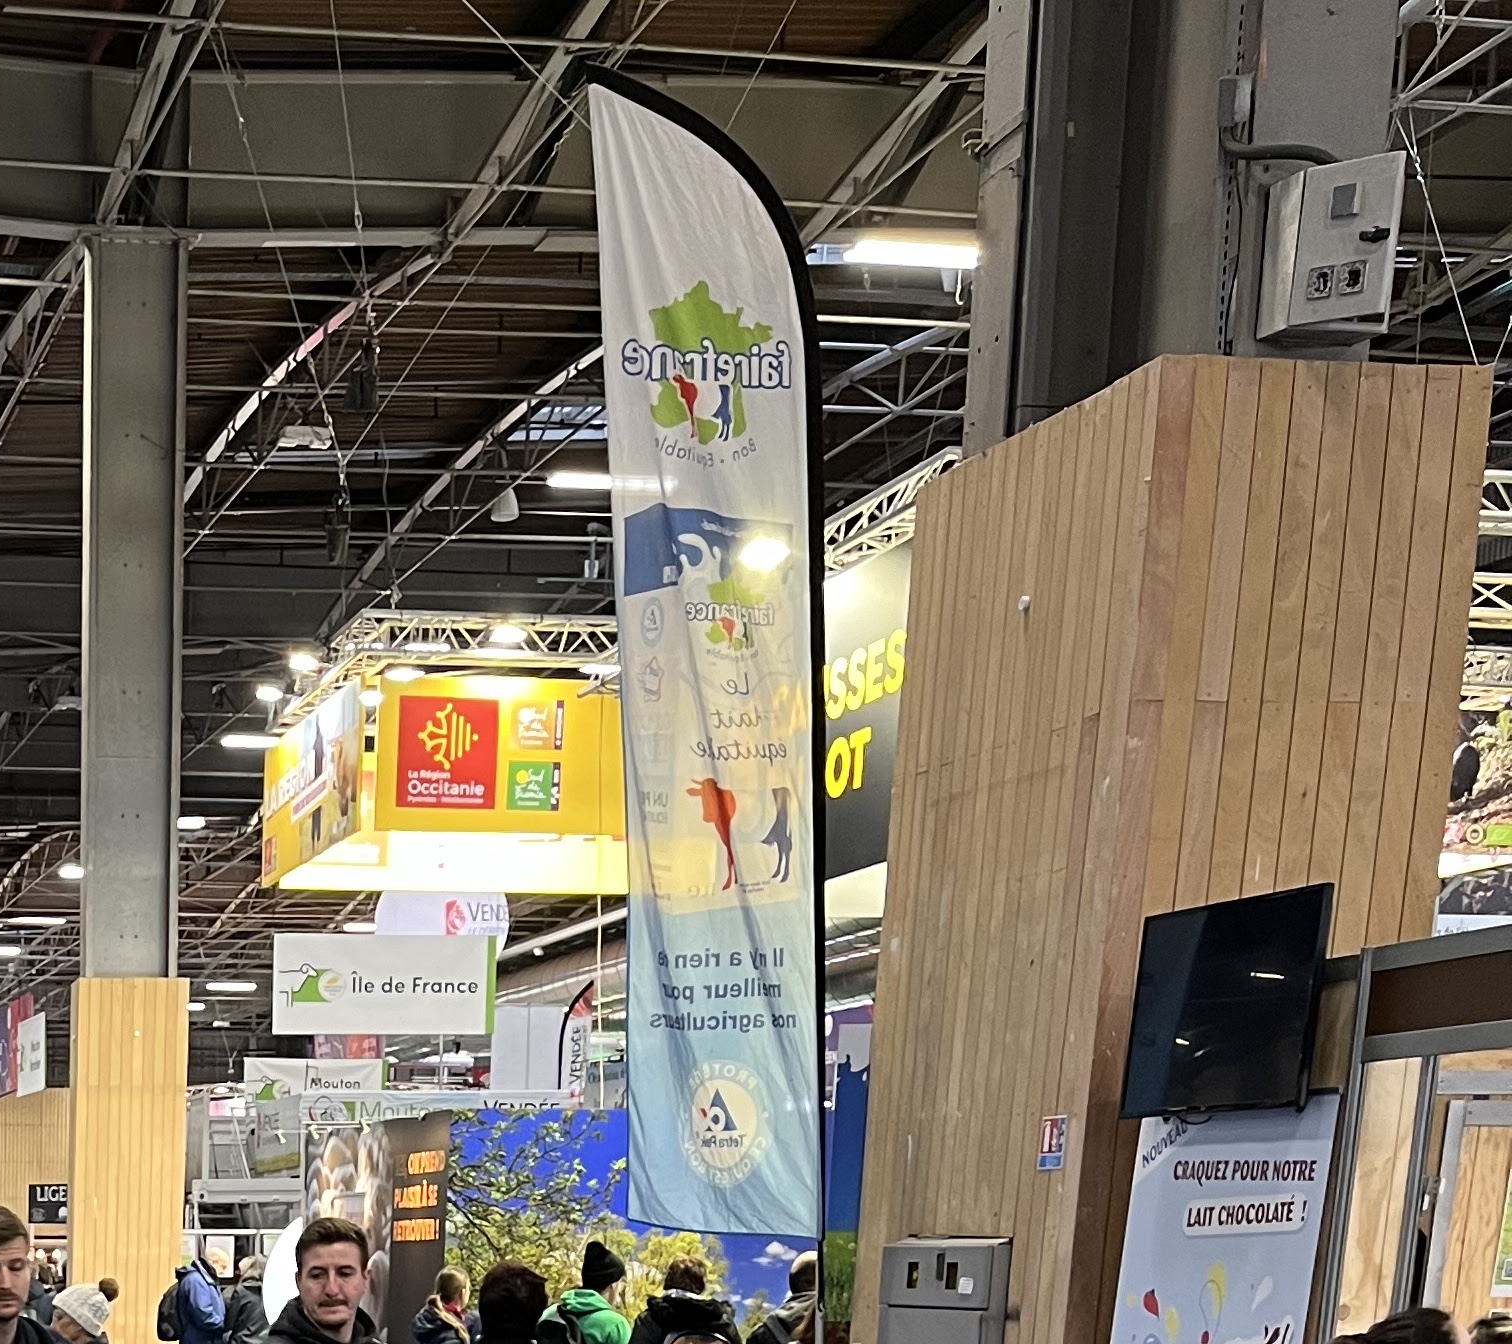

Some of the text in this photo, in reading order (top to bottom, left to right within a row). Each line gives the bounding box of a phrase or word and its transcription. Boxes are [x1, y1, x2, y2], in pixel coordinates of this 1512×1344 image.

[823, 629, 907, 720] SSES
[408, 769, 451, 781] La Région
[408, 780, 485, 796] Occitanie
[351, 970, 478, 994] Île de France
[310, 1078, 361, 1090] Mouton
[1173, 1159, 1318, 1187] CRAQUEZ POUR NOTRE
[1186, 1206, 1216, 1228] LAIT
[1218, 1194, 1296, 1226] CHOCOLATÉ
